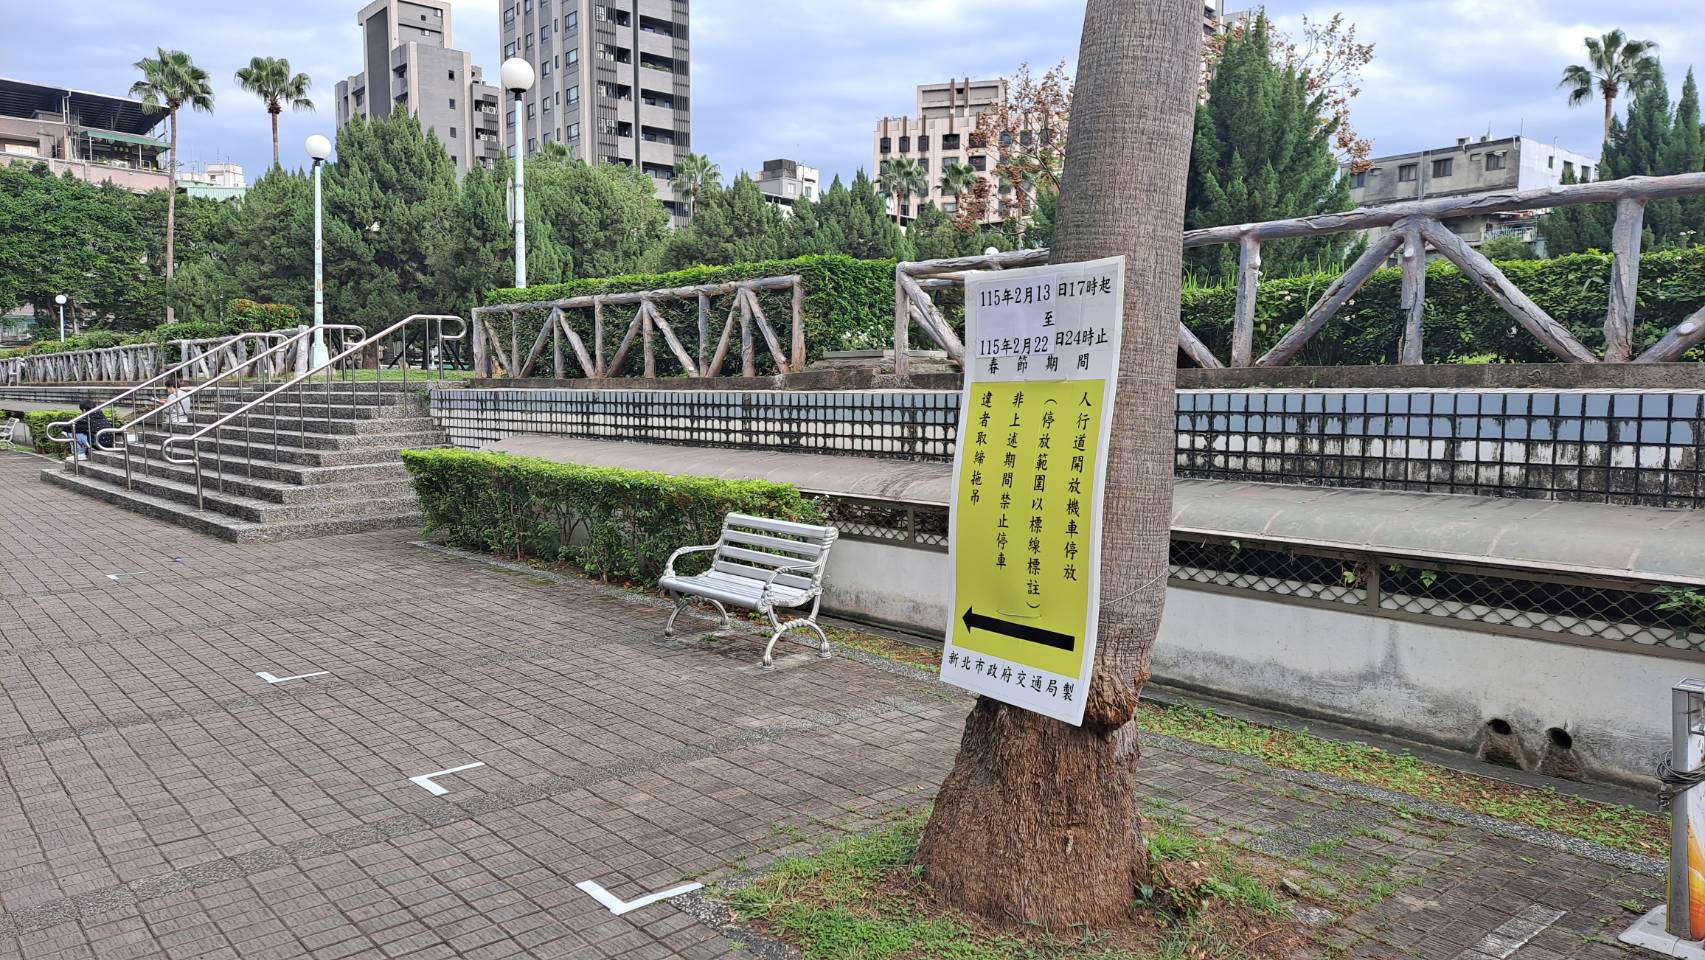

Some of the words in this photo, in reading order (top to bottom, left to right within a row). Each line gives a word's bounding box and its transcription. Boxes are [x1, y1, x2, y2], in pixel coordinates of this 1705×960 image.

[980, 275, 1112, 307] 115年2月13日17時起
[1042, 310, 1055, 327] 至
[980, 327, 1108, 356] 115年2月22日24時止
[987, 352, 1090, 374] 春節期間
[970, 391, 993, 506] 違者取締拖吊
[995, 391, 1024, 570] 非上述期間禁止停車
[1063, 391, 1092, 581] 人行道開放機車停放
[948, 650, 1075, 701] 新北市政府交通局製
